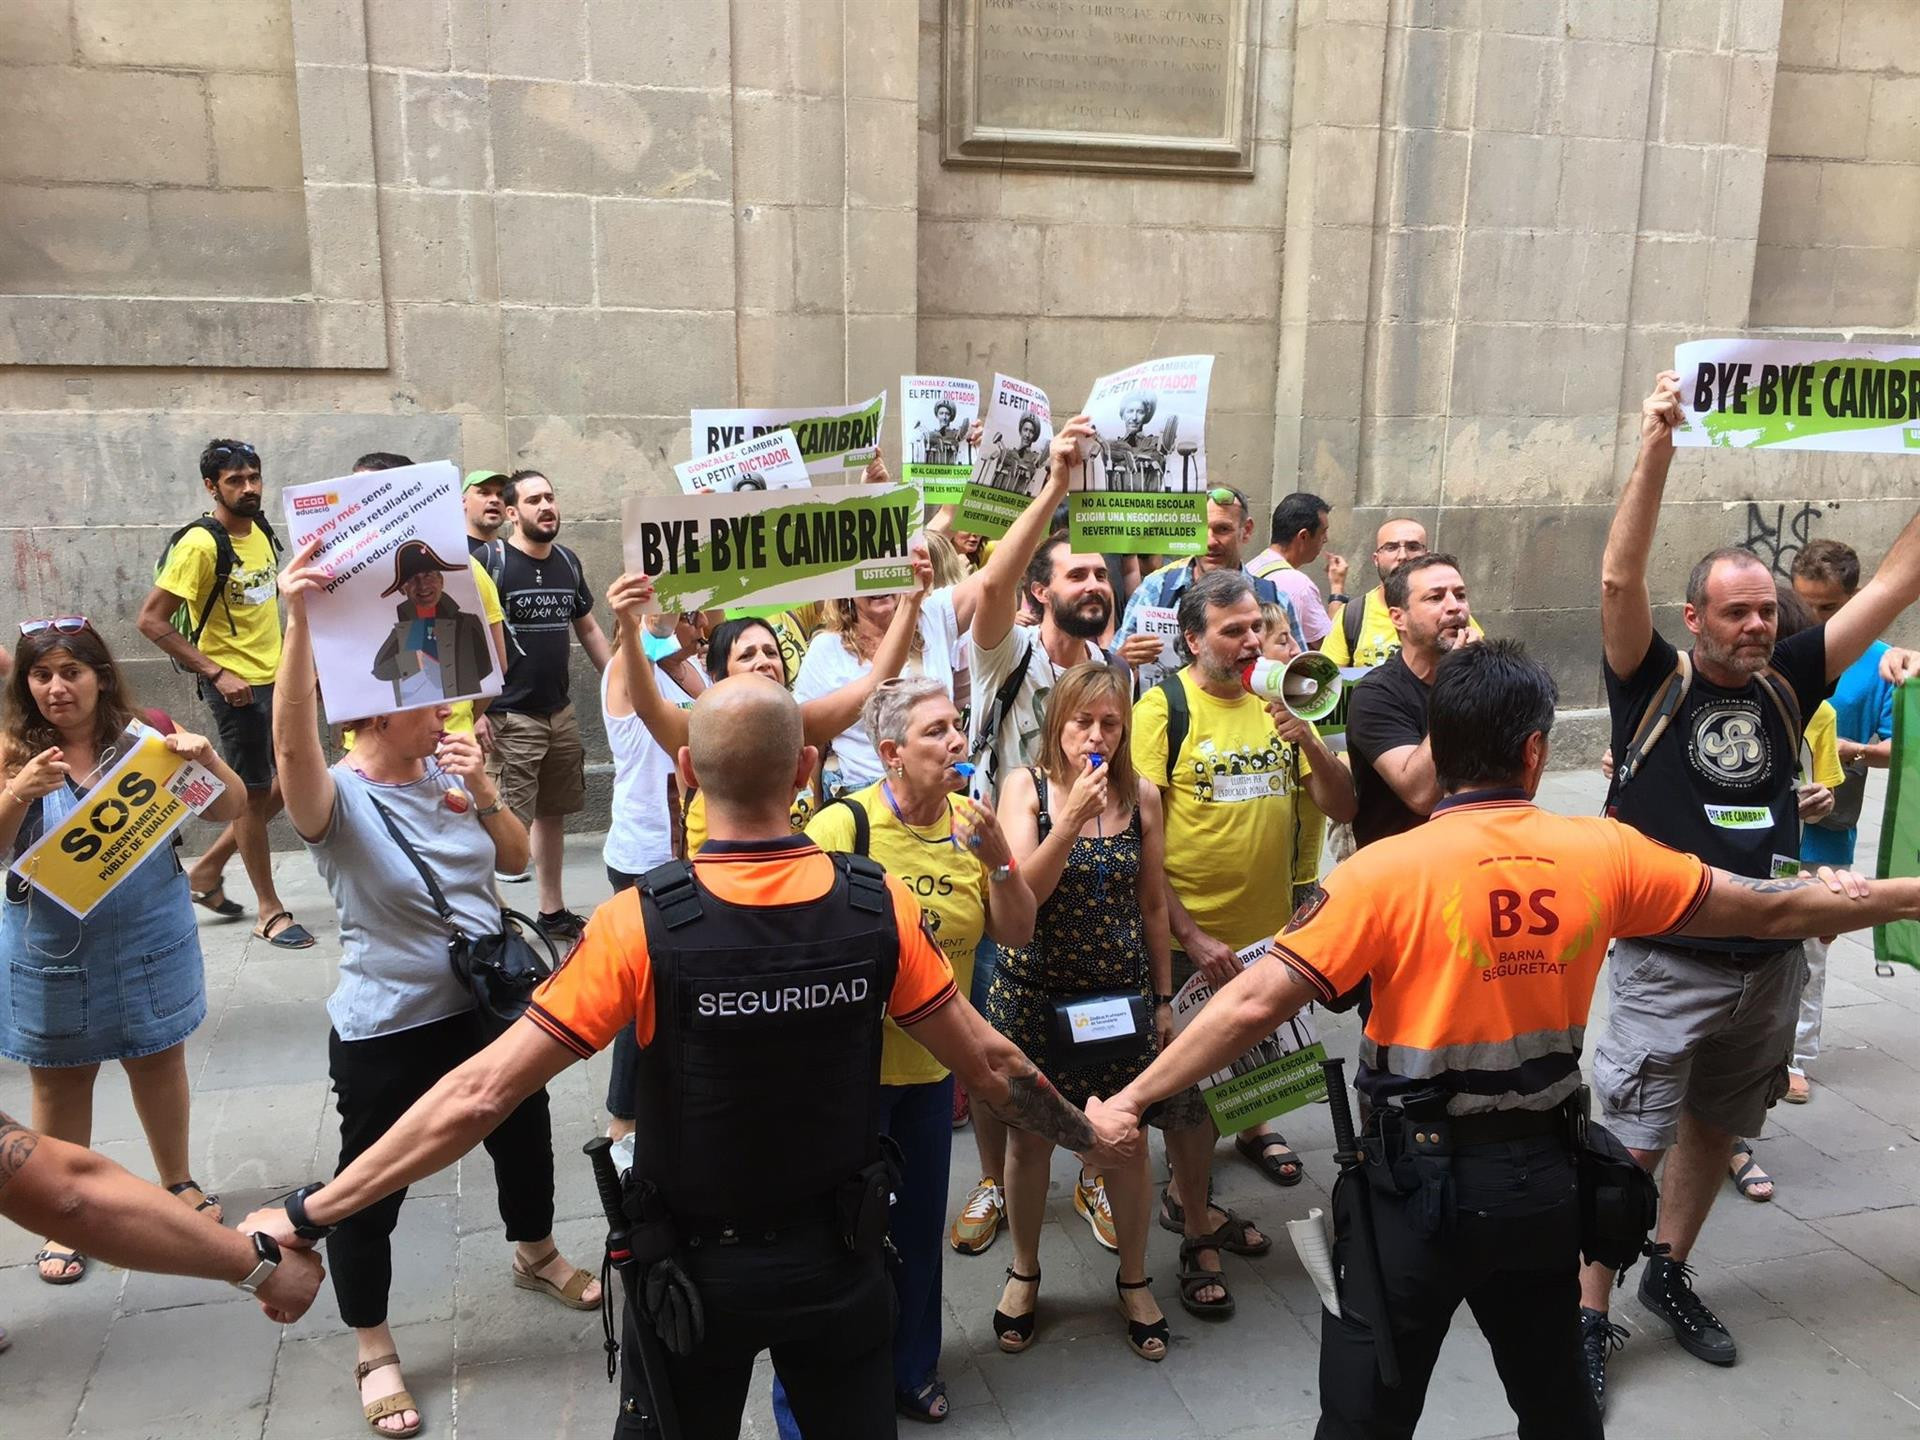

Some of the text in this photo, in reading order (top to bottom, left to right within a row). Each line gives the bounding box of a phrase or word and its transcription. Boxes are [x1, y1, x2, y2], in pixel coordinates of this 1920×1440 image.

[909, 389, 975, 402] EL PETIT DICTADOR
[1141, 375, 1197, 389] DICTADOR
[1693, 362, 1920, 420] BYE BYE CAMBR
[999, 391, 1050, 419] EL PETIT DICTA
[740, 436, 784, 456] CAMBRAY
[798, 411, 882, 456] CAMBRAY
[692, 477, 707, 489] EL
[707, 465, 737, 485] PETIT
[738, 448, 791, 474] DICTADOR
[295, 506, 330, 517] educació
[297, 481, 393, 547] Un any més sense
[1076, 511, 1203, 523] EXIGIM UNA NEGOCIACIÓ REAL
[1082, 498, 1195, 509] NO AL CALENDARI ESCOLAR
[309, 481, 424, 561] revertir les retallades!
[334, 545, 354, 566] any
[354, 529, 379, 551] més
[379, 510, 410, 535] sense
[409, 483, 451, 514] invertir
[1082, 526, 1196, 536] REVERTIM LES RETALLADES
[640, 506, 910, 577] BYE BYE CAMBRAY
[325, 524, 419, 594] prou en educació!
[1145, 610, 1176, 620] GONZAL
[1145, 621, 1180, 634] EL PETIT
[61, 772, 156, 862] SOS
[1708, 809, 1766, 822] BYE BYE CAMBRAY
[98, 798, 180, 881] PÚBLIC DE QUALITAT
[100, 801, 160, 863] ENSENYAMENT
[901, 874, 953, 896] SOS
[1489, 888, 1560, 938] BS
[1239, 945, 1267, 965] BRAY
[1500, 950, 1544, 962] BARNA
[1482, 962, 1567, 983] SEGURETAT
[698, 977, 868, 1016] SEGURIDAD
[1178, 985, 1214, 1015] EL PETI
[1215, 1051, 1316, 1100] NO AL CALENDARI ESCOLAR
[1224, 1073, 1326, 1120] REVERTIM LES RETALLADES
[1242, 1088, 1260, 1101] UNA
